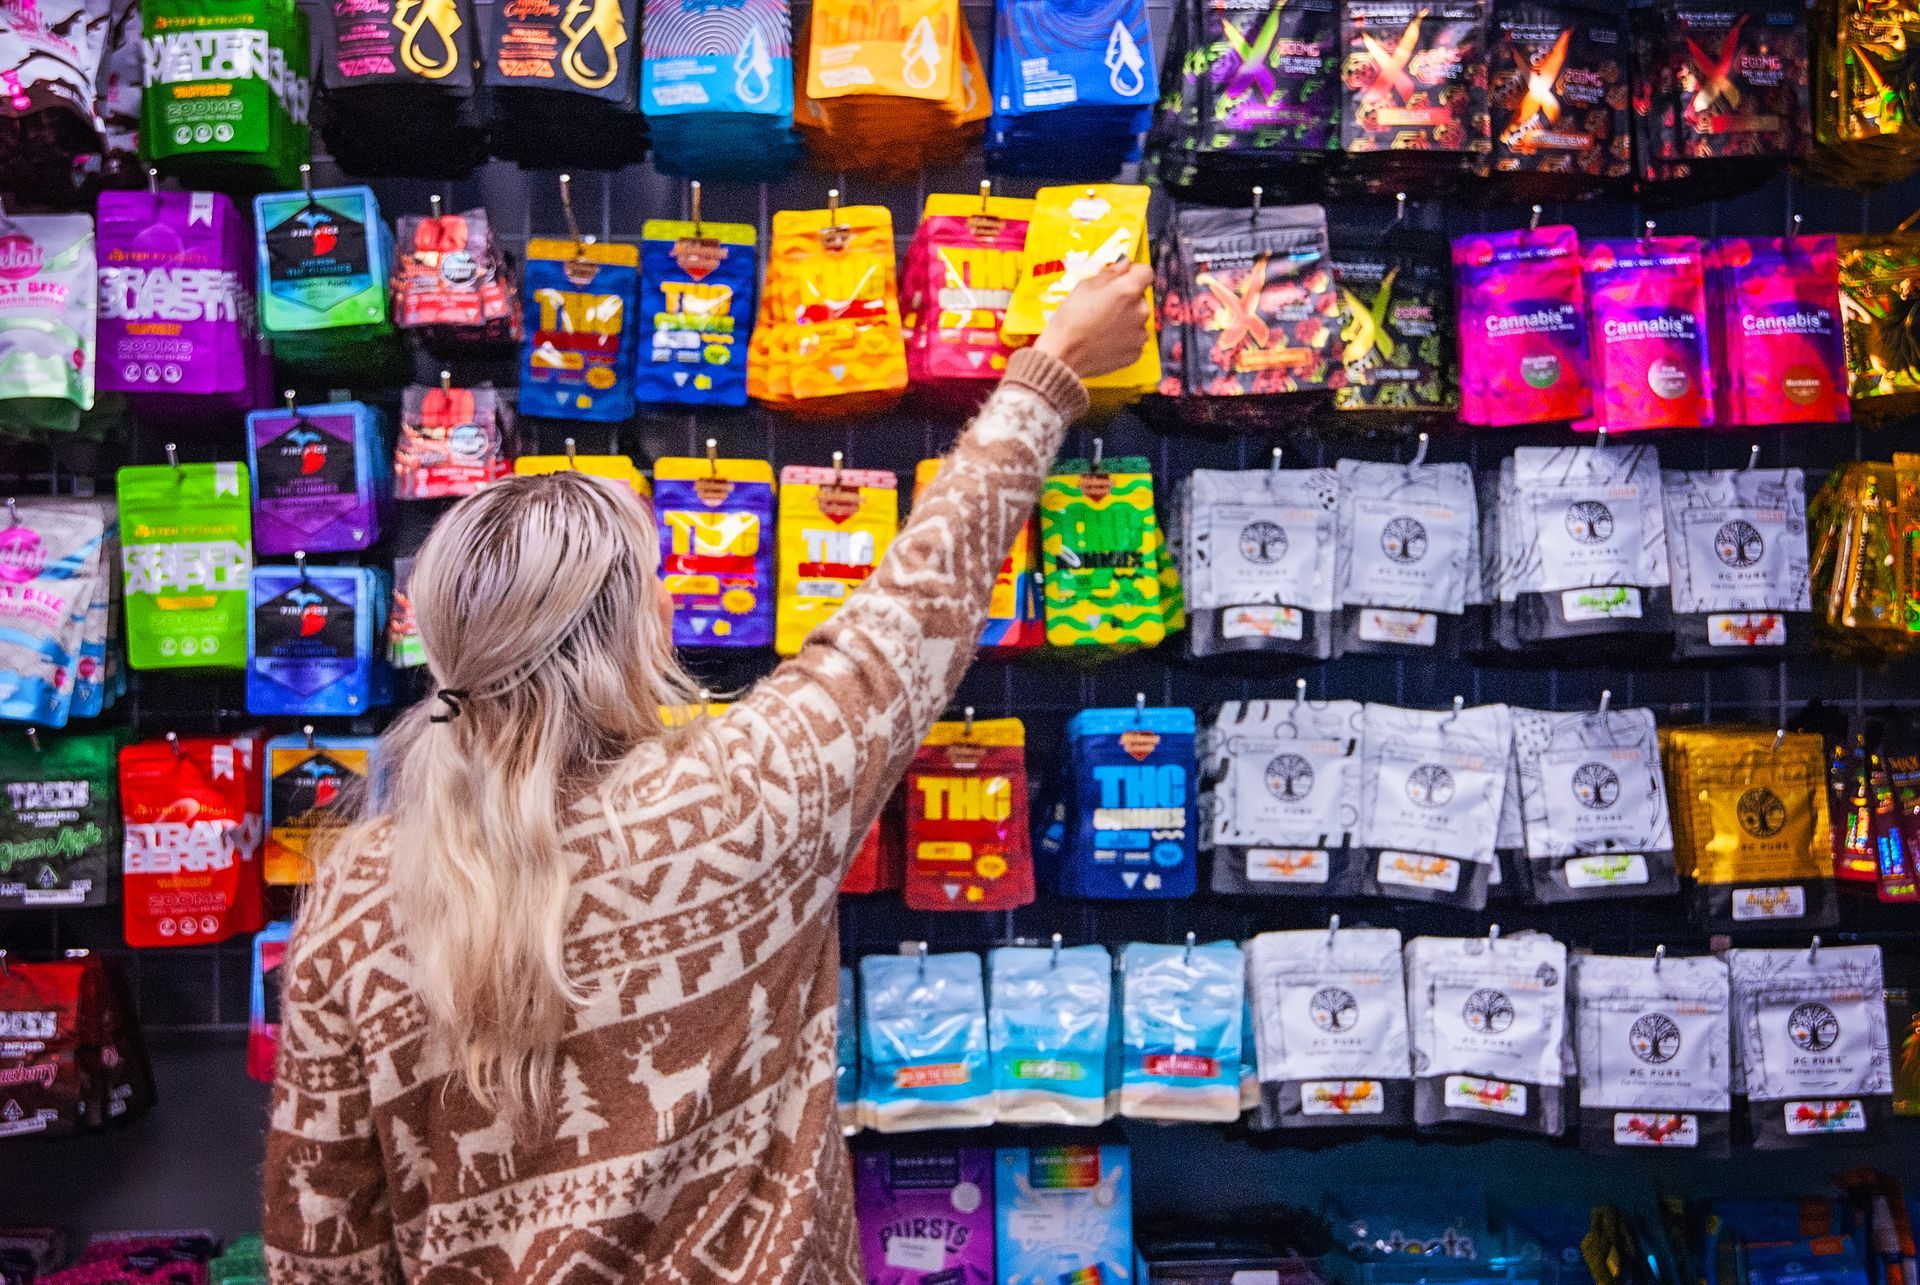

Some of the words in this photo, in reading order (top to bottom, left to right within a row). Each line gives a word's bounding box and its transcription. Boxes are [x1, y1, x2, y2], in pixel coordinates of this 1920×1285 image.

[142, 29, 268, 60] WATER
[144, 48, 268, 87] MELON
[1486, 309, 1563, 332] Cannabis
[1604, 316, 1684, 337] Cannabis
[1742, 311, 1820, 330] Cannabis
[917, 776, 1012, 821] THC
[1093, 764, 1186, 808] THC
